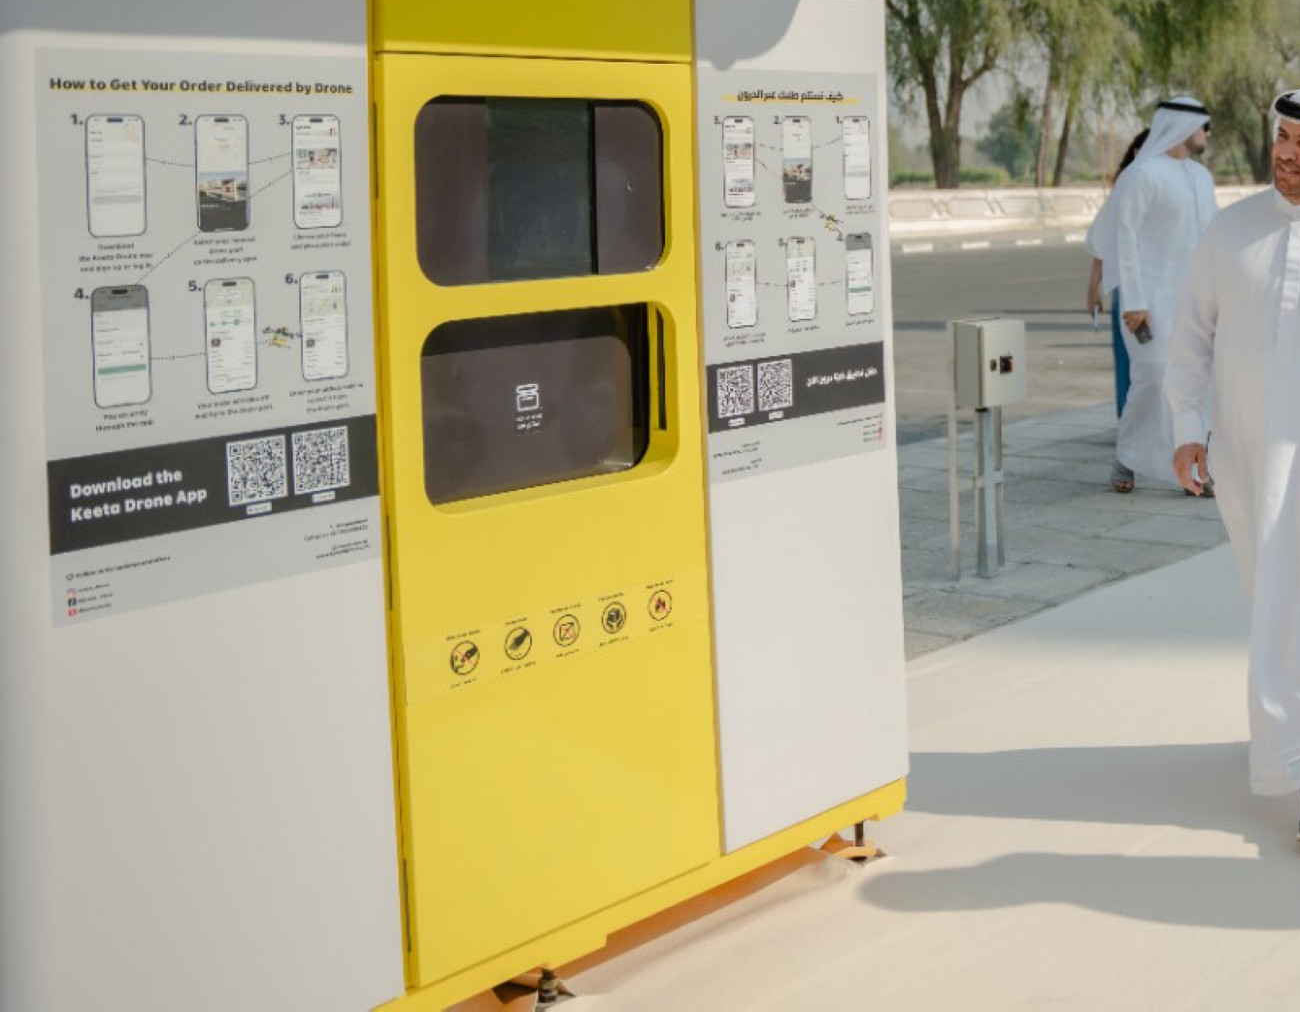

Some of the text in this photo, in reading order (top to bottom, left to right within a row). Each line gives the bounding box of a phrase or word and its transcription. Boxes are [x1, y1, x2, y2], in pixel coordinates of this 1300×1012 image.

[49, 78, 353, 95] How to Get Your Order Delivered by Drone
[70, 113, 84, 125] 1.
[178, 113, 193, 125] 2.
[279, 113, 291, 125] 3.
[285, 272, 299, 285] 6.
[188, 279, 203, 292] 5.
[74, 288, 89, 299] 4.
[70, 469, 182, 499] Download the
[71, 488, 207, 522] Keeta Drone App
